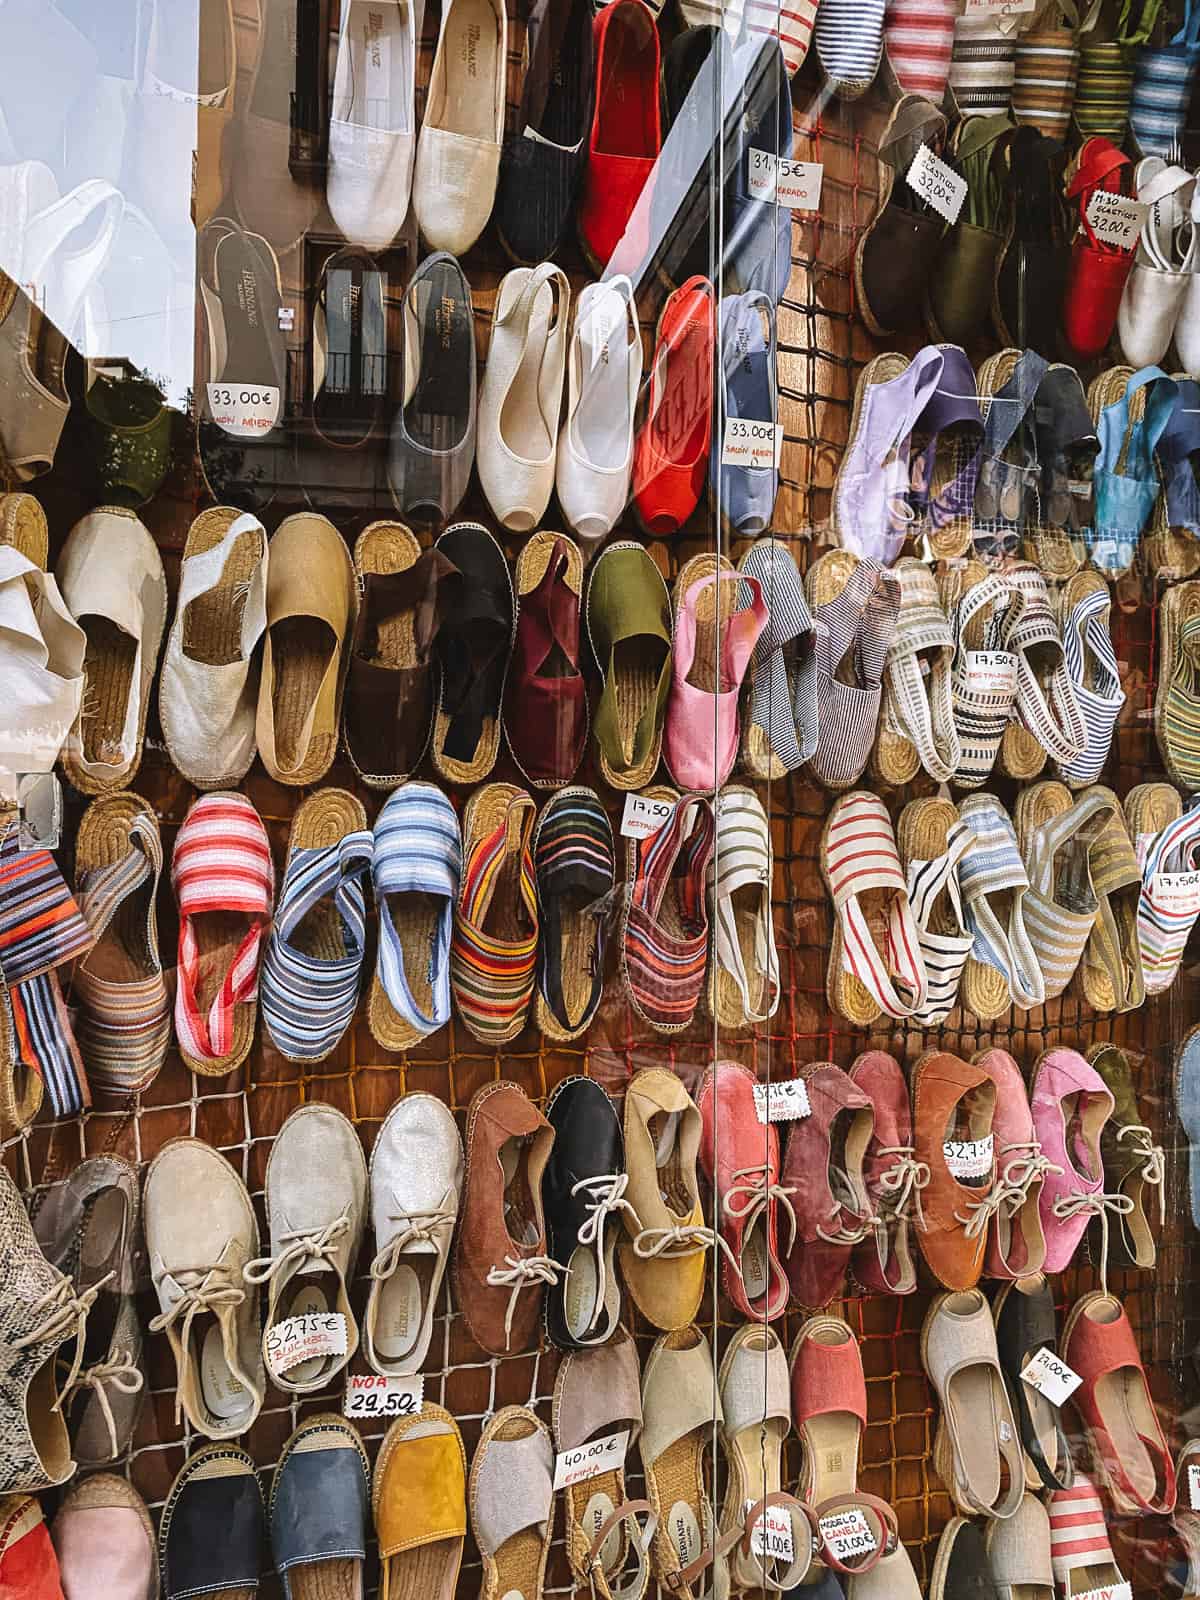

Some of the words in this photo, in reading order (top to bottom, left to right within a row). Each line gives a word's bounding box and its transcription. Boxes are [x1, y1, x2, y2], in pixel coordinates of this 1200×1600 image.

[352, 1376, 387, 1389] NOA
[565, 1438, 617, 1467] 40,00€
[825, 1521, 867, 1543] CANELA
